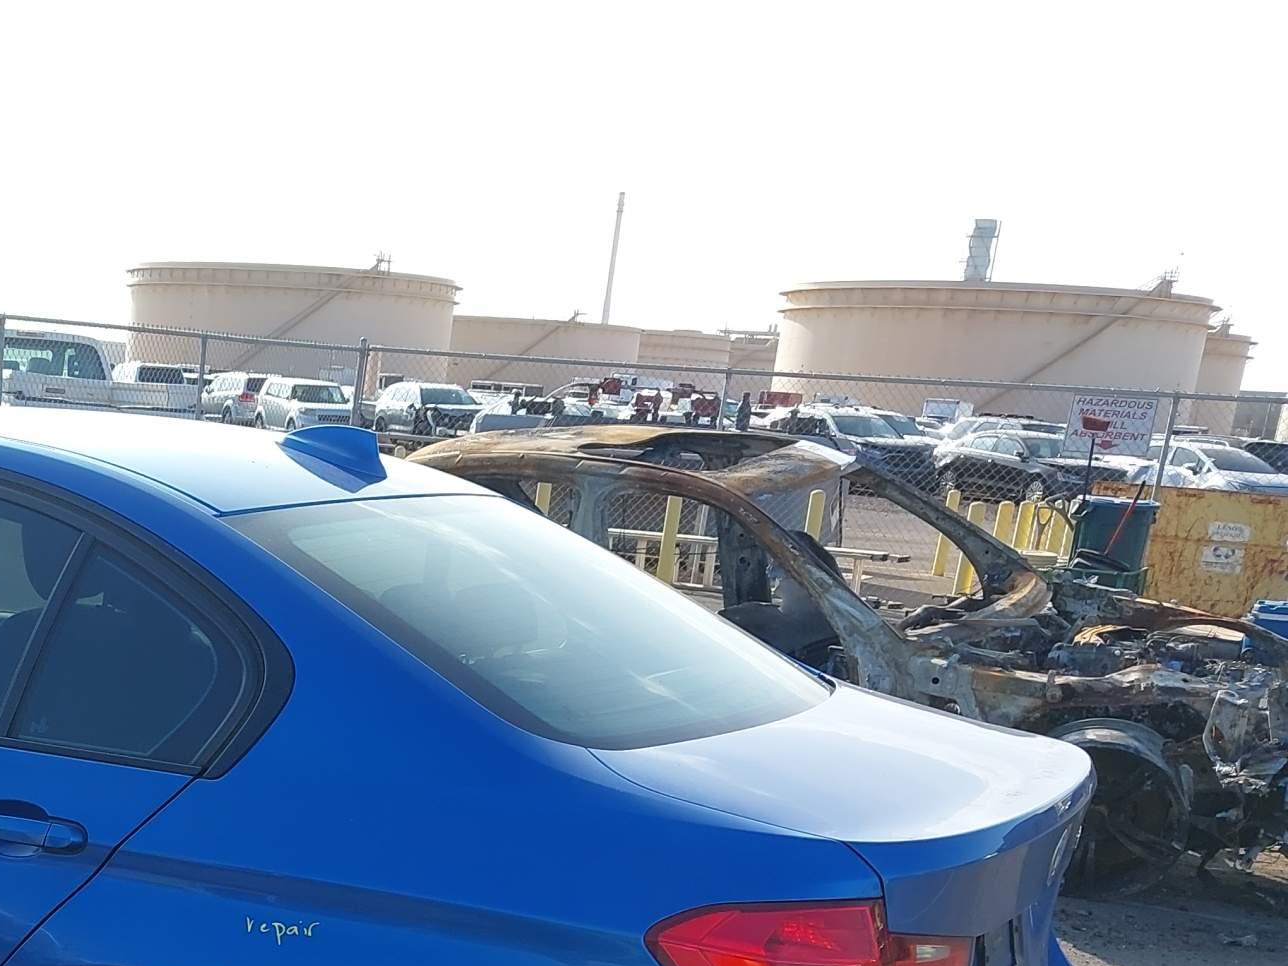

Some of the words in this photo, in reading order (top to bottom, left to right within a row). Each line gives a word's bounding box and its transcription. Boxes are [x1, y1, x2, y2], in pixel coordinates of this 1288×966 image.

[1076, 397, 1154, 410] HAZARDOUS
[1078, 407, 1148, 420] MATERIALS
[1070, 429, 1148, 441] ABSORBENT
[245, 915, 321, 946] repair
